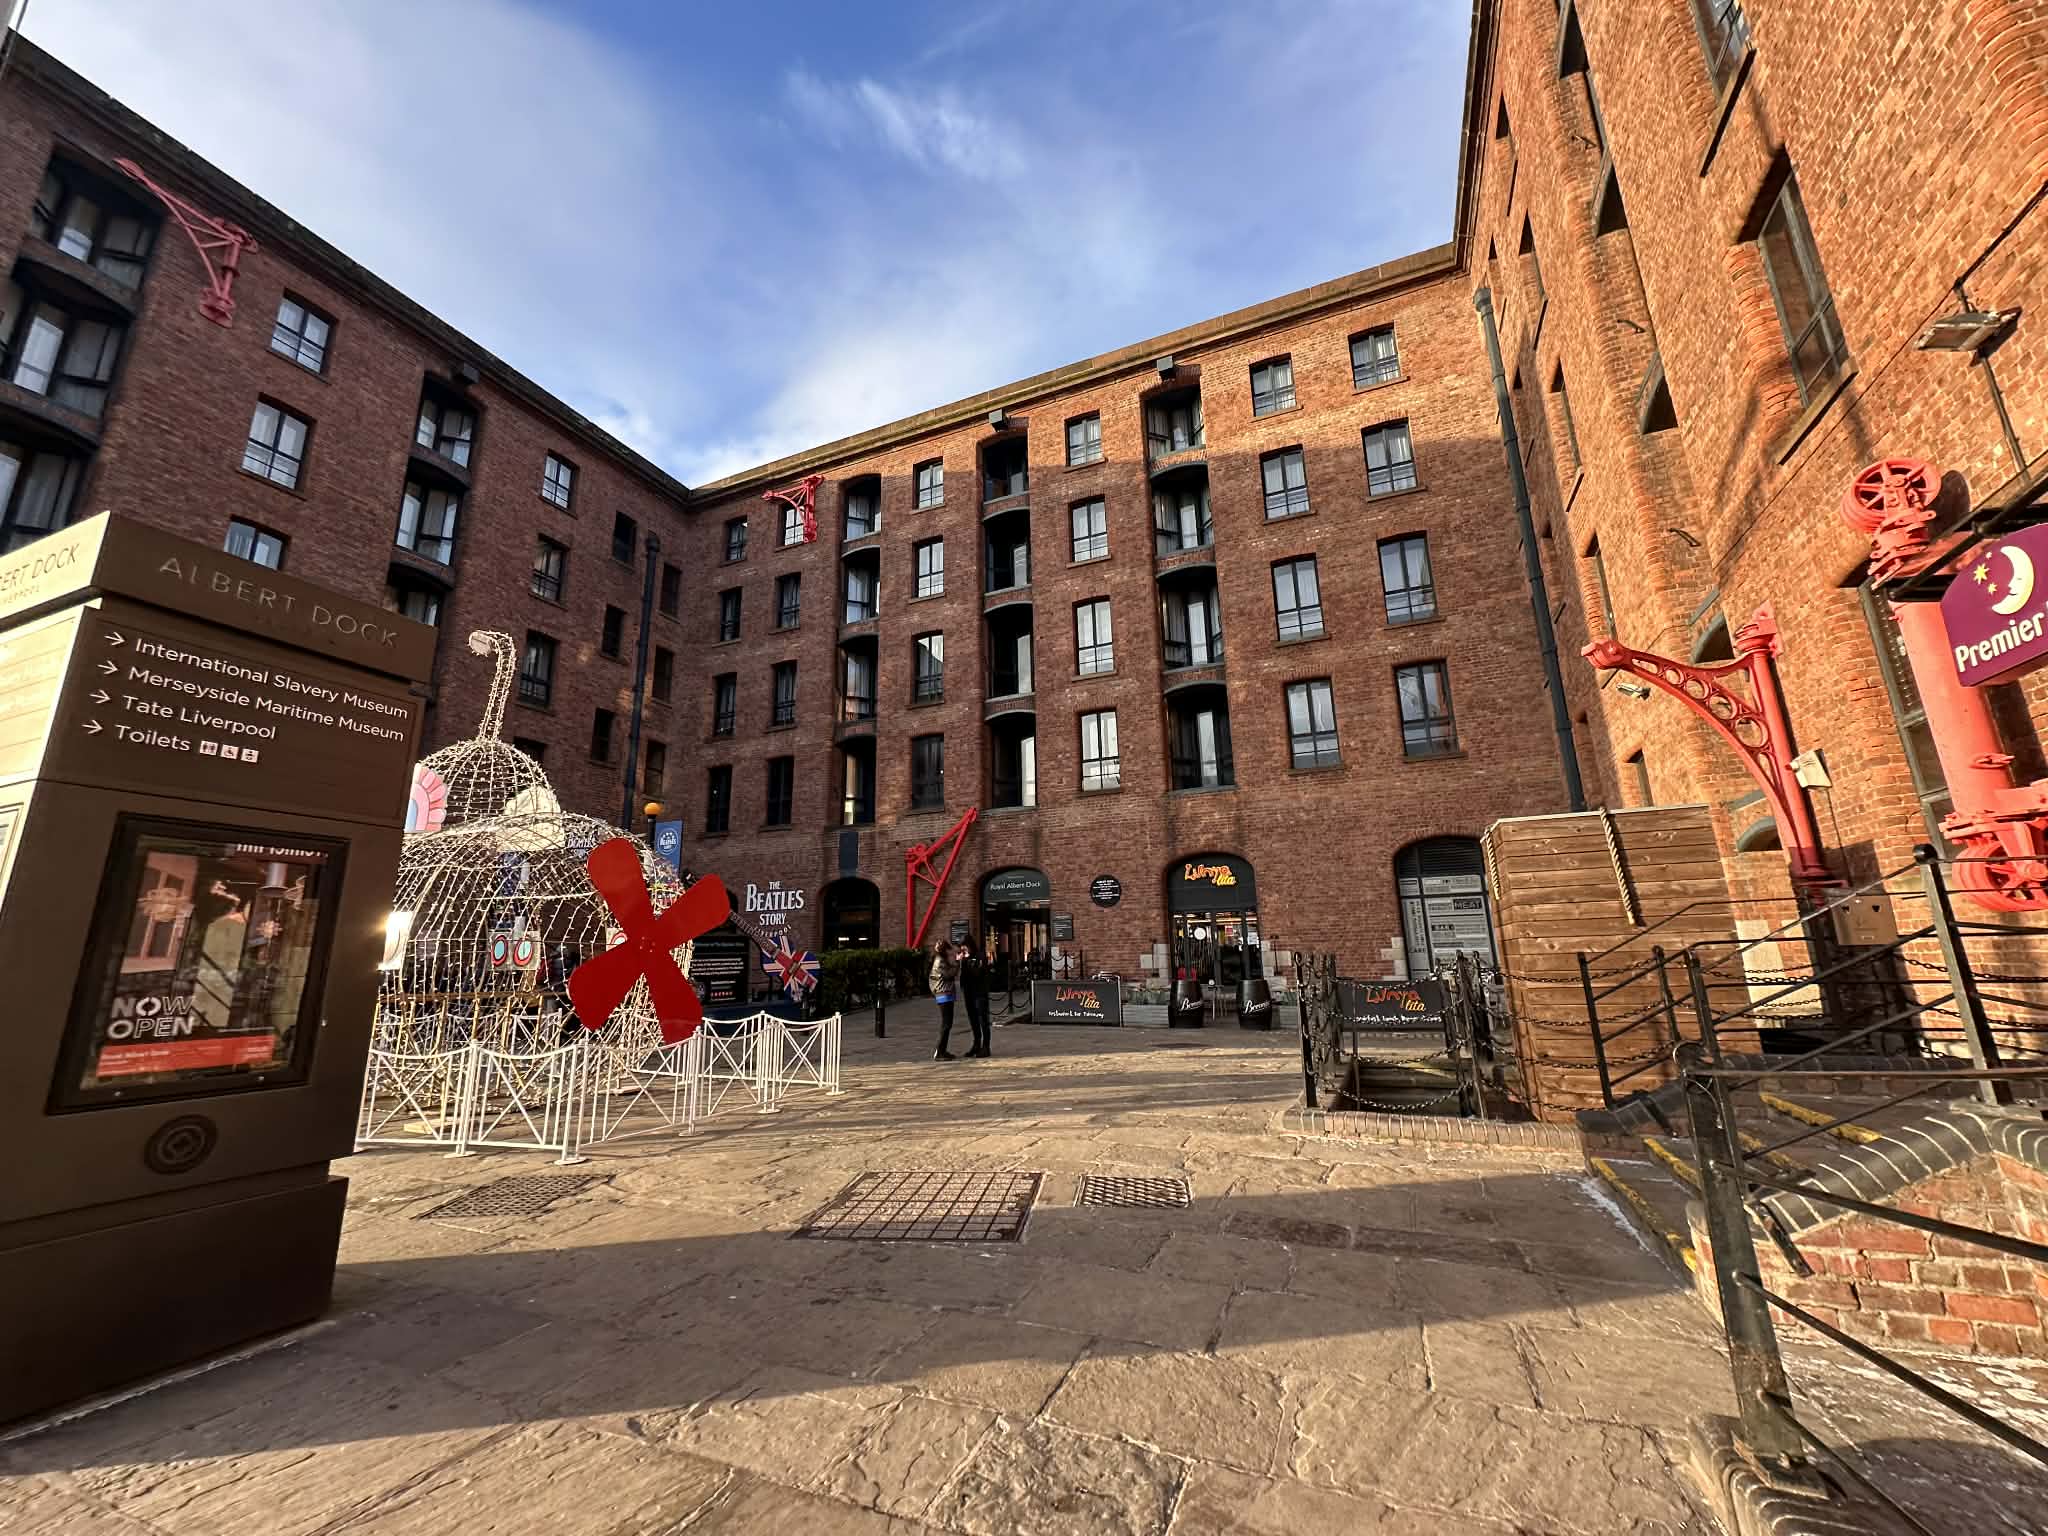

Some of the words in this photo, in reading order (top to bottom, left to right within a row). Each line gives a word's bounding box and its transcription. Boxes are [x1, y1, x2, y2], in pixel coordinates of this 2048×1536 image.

[32, 544, 79, 579] DOCK
[312, 605, 397, 646] DOCK
[1955, 612, 2045, 673] Premier
[136, 637, 269, 684] International
[273, 674, 339, 703] Slavery
[343, 692, 409, 720] Museum
[122, 695, 174, 719] Tate
[180, 707, 276, 740] Liverpool
[128, 666, 250, 707] Merseyside
[256, 696, 334, 726] Maritime
[338, 716, 405, 743] Museum
[114, 724, 192, 752] Toilets
[746, 884, 804, 912] BEATLES
[769, 881, 781, 890] THE
[760, 912, 787, 926] STORY
[112, 996, 196, 1018] NOW
[108, 1016, 195, 1040] OPEN
